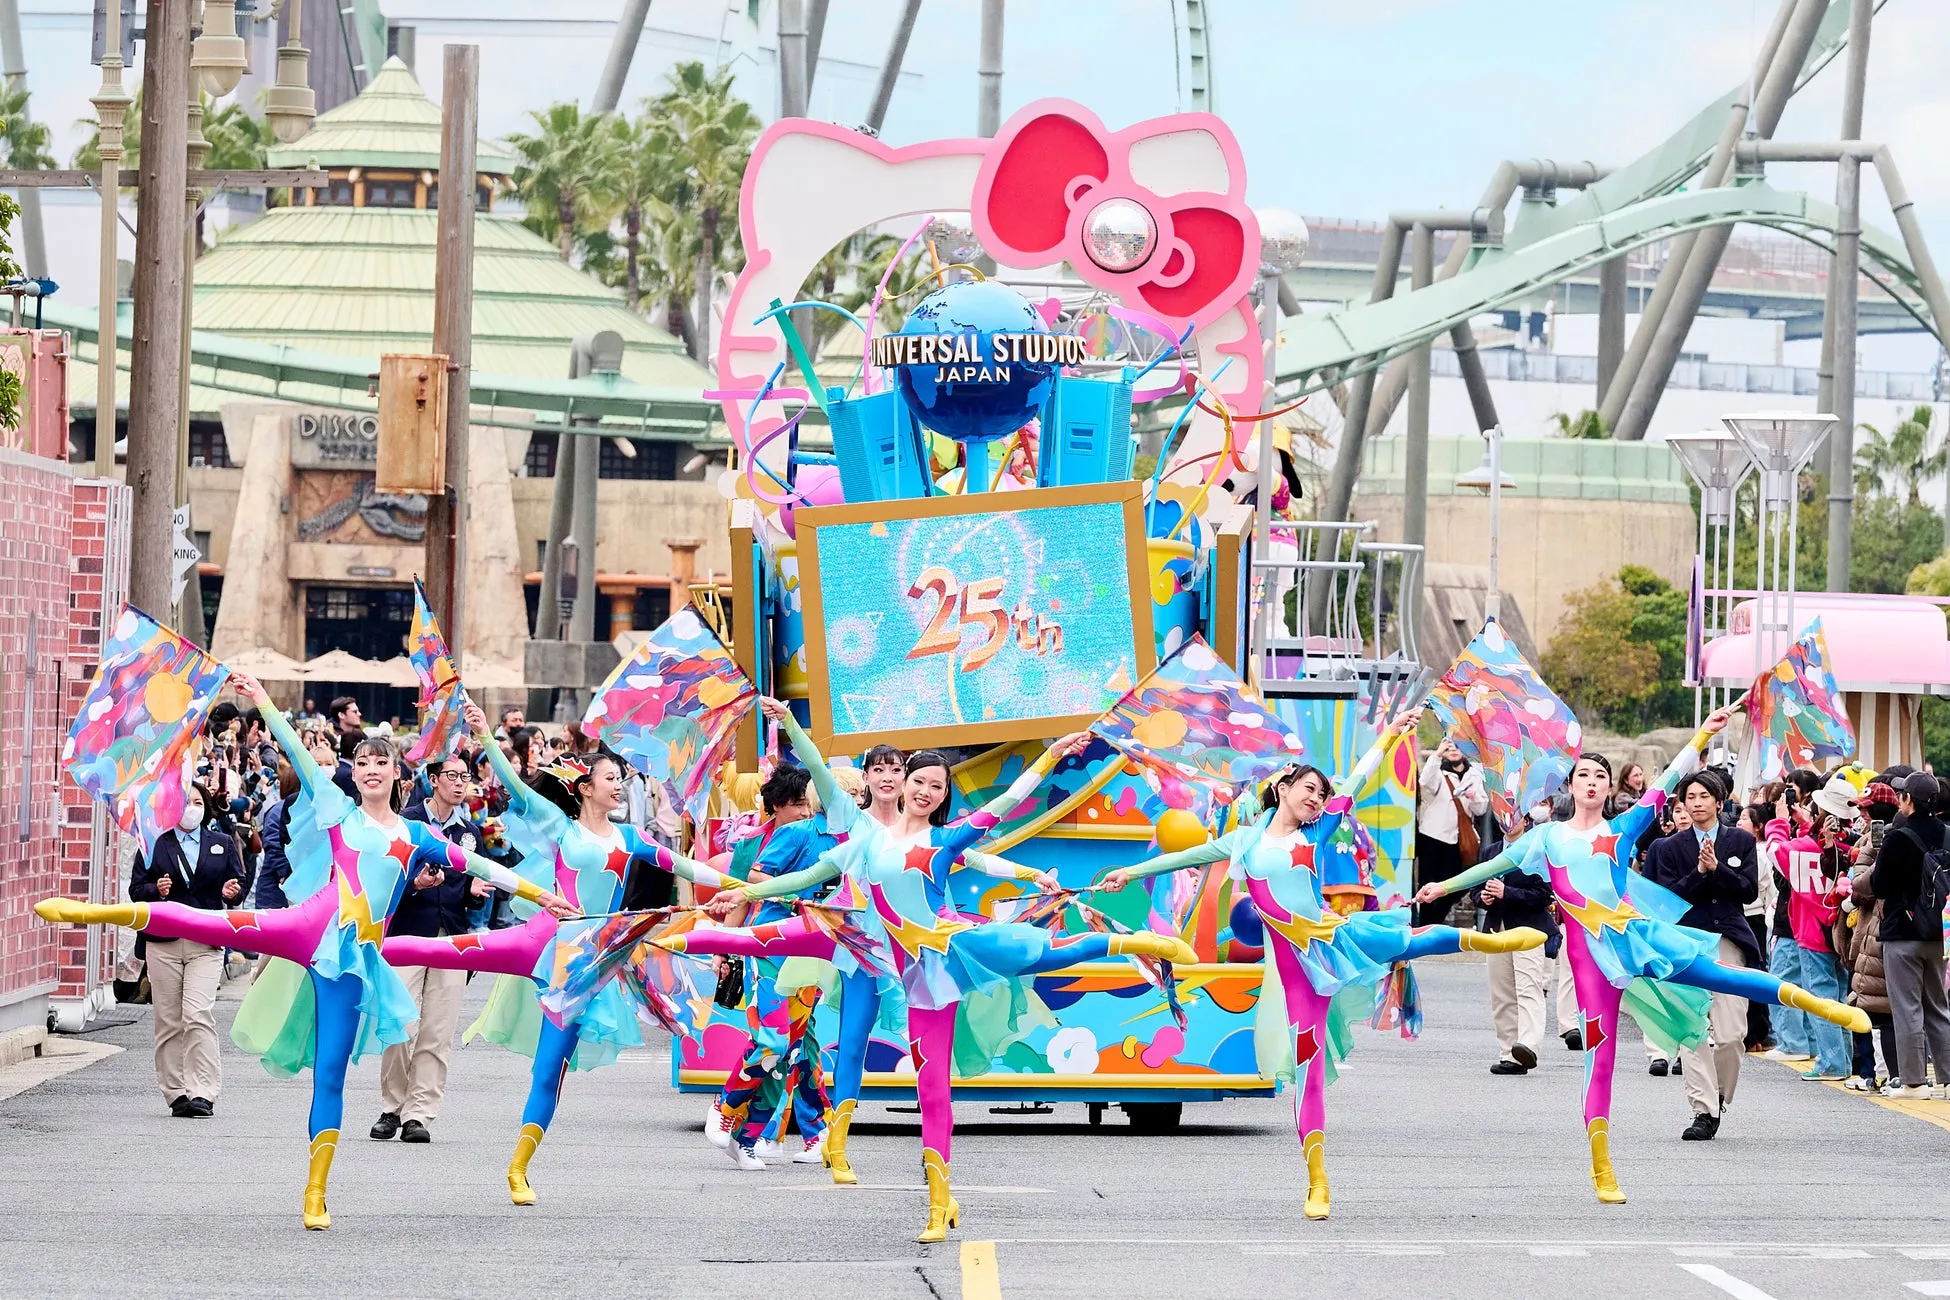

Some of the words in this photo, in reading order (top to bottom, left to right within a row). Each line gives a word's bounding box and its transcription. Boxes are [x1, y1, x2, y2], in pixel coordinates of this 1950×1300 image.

[871, 332, 983, 366] UNIVERSAL
[993, 332, 1087, 365] STUDIOS
[934, 366, 1011, 383] JAPAN
[905, 566, 1063, 674] 25th
